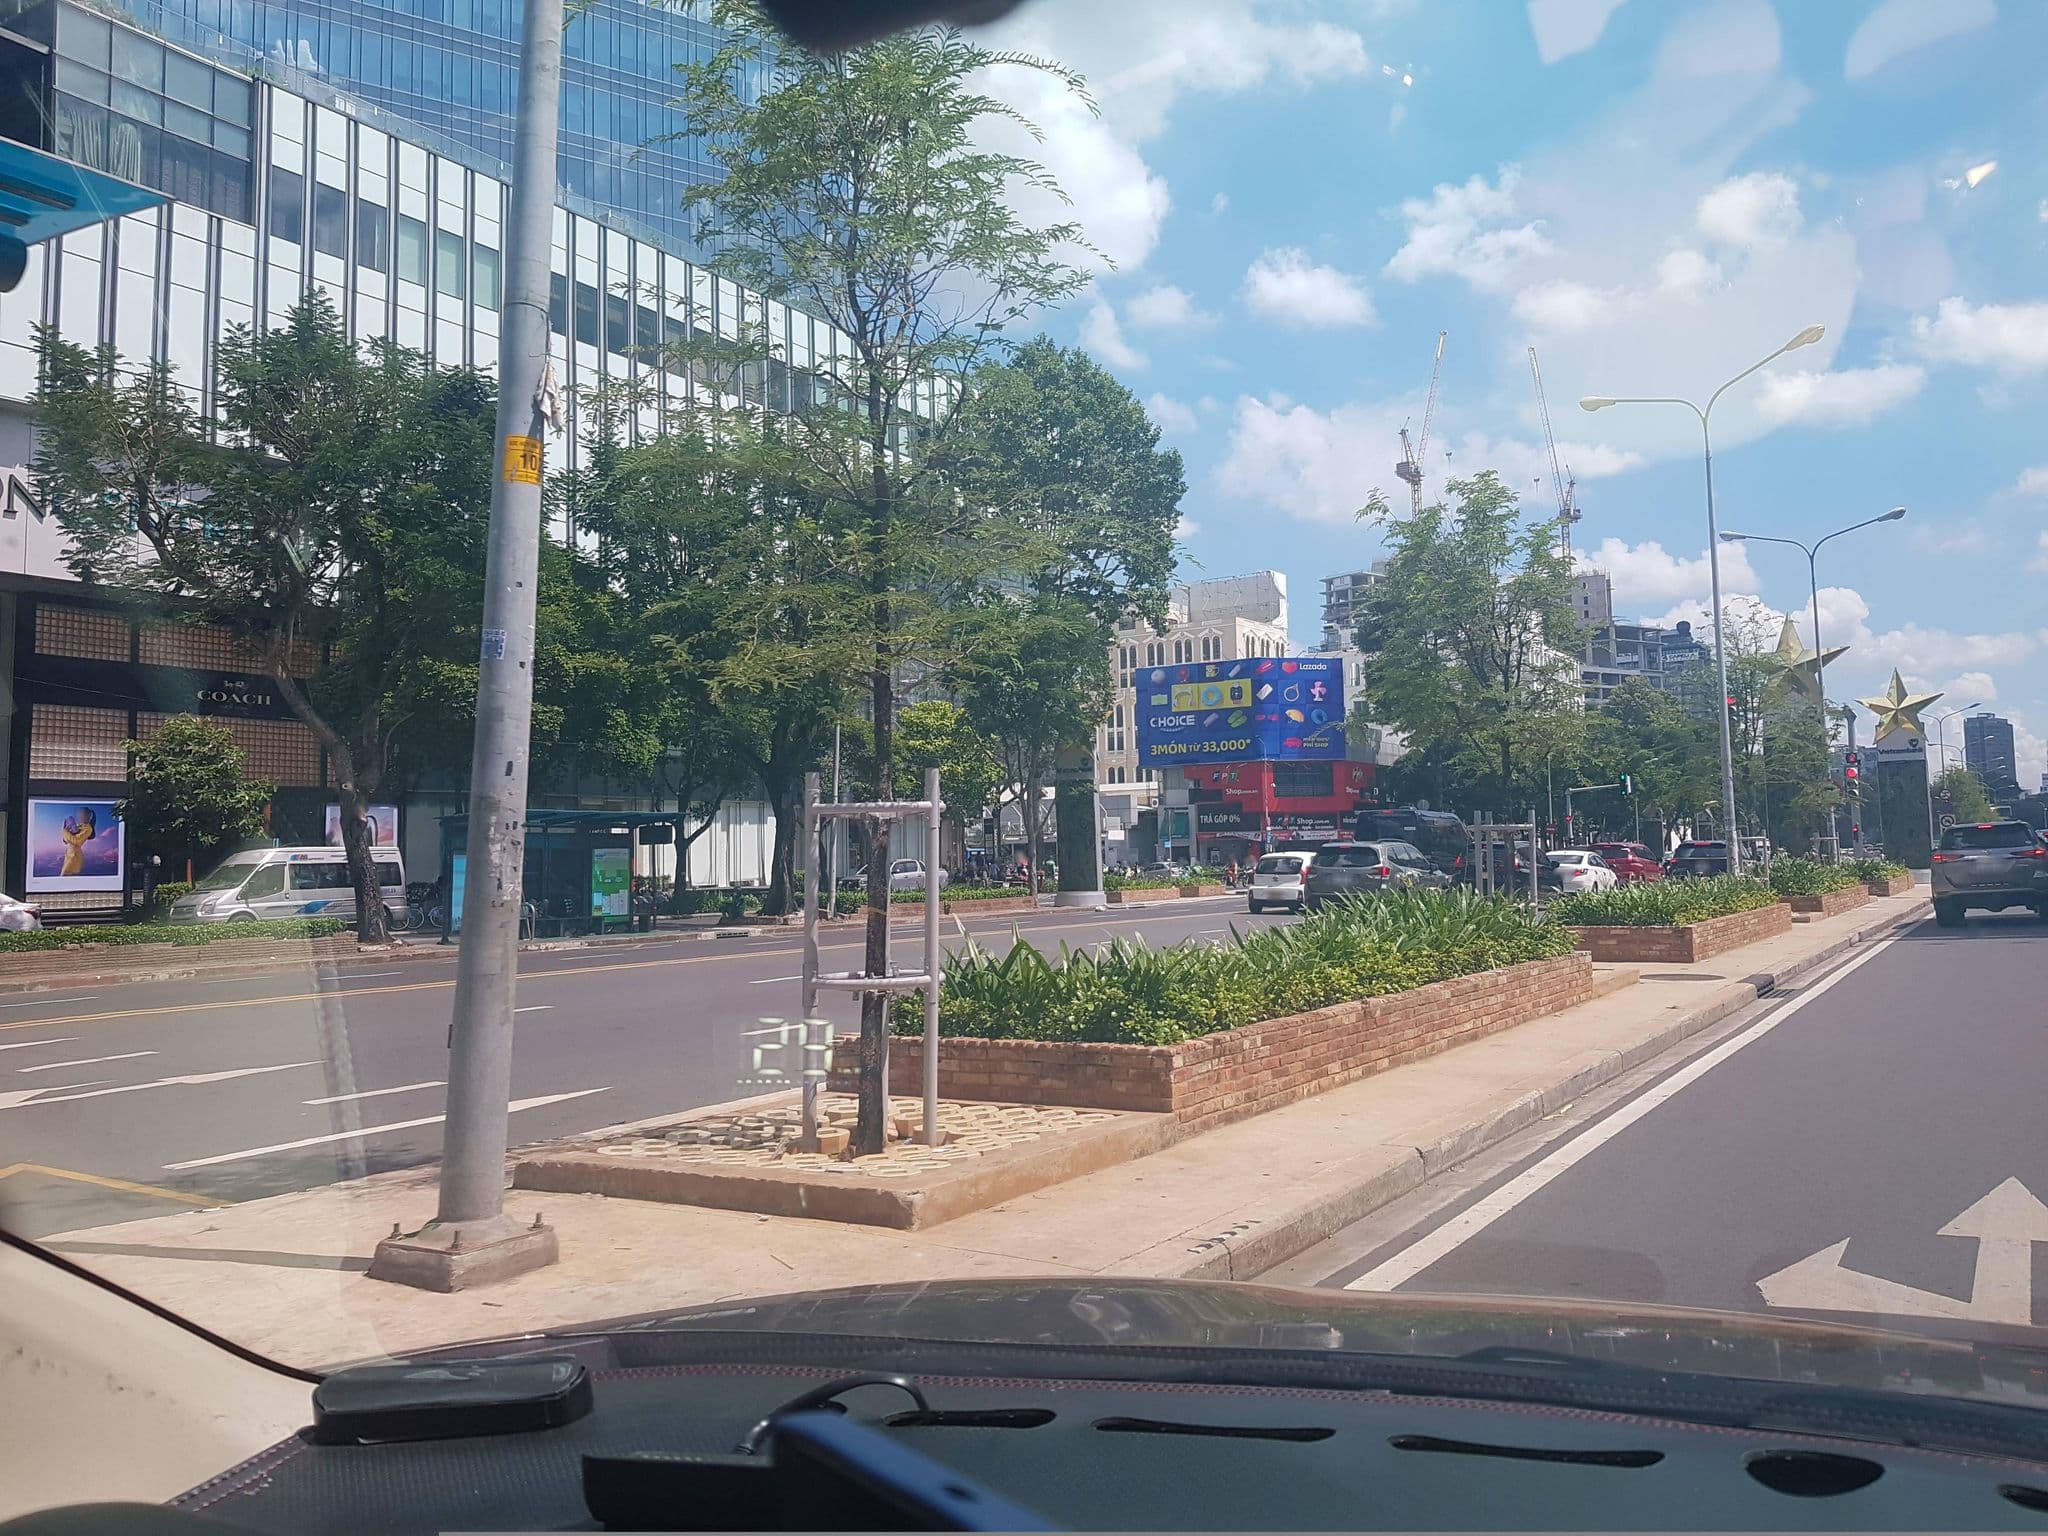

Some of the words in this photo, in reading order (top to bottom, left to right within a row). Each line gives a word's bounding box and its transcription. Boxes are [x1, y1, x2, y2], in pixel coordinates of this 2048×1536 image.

[1299, 663, 1328, 671] Lazada
[197, 689, 271, 706] COACH
[1228, 814, 1240, 824] 0%
